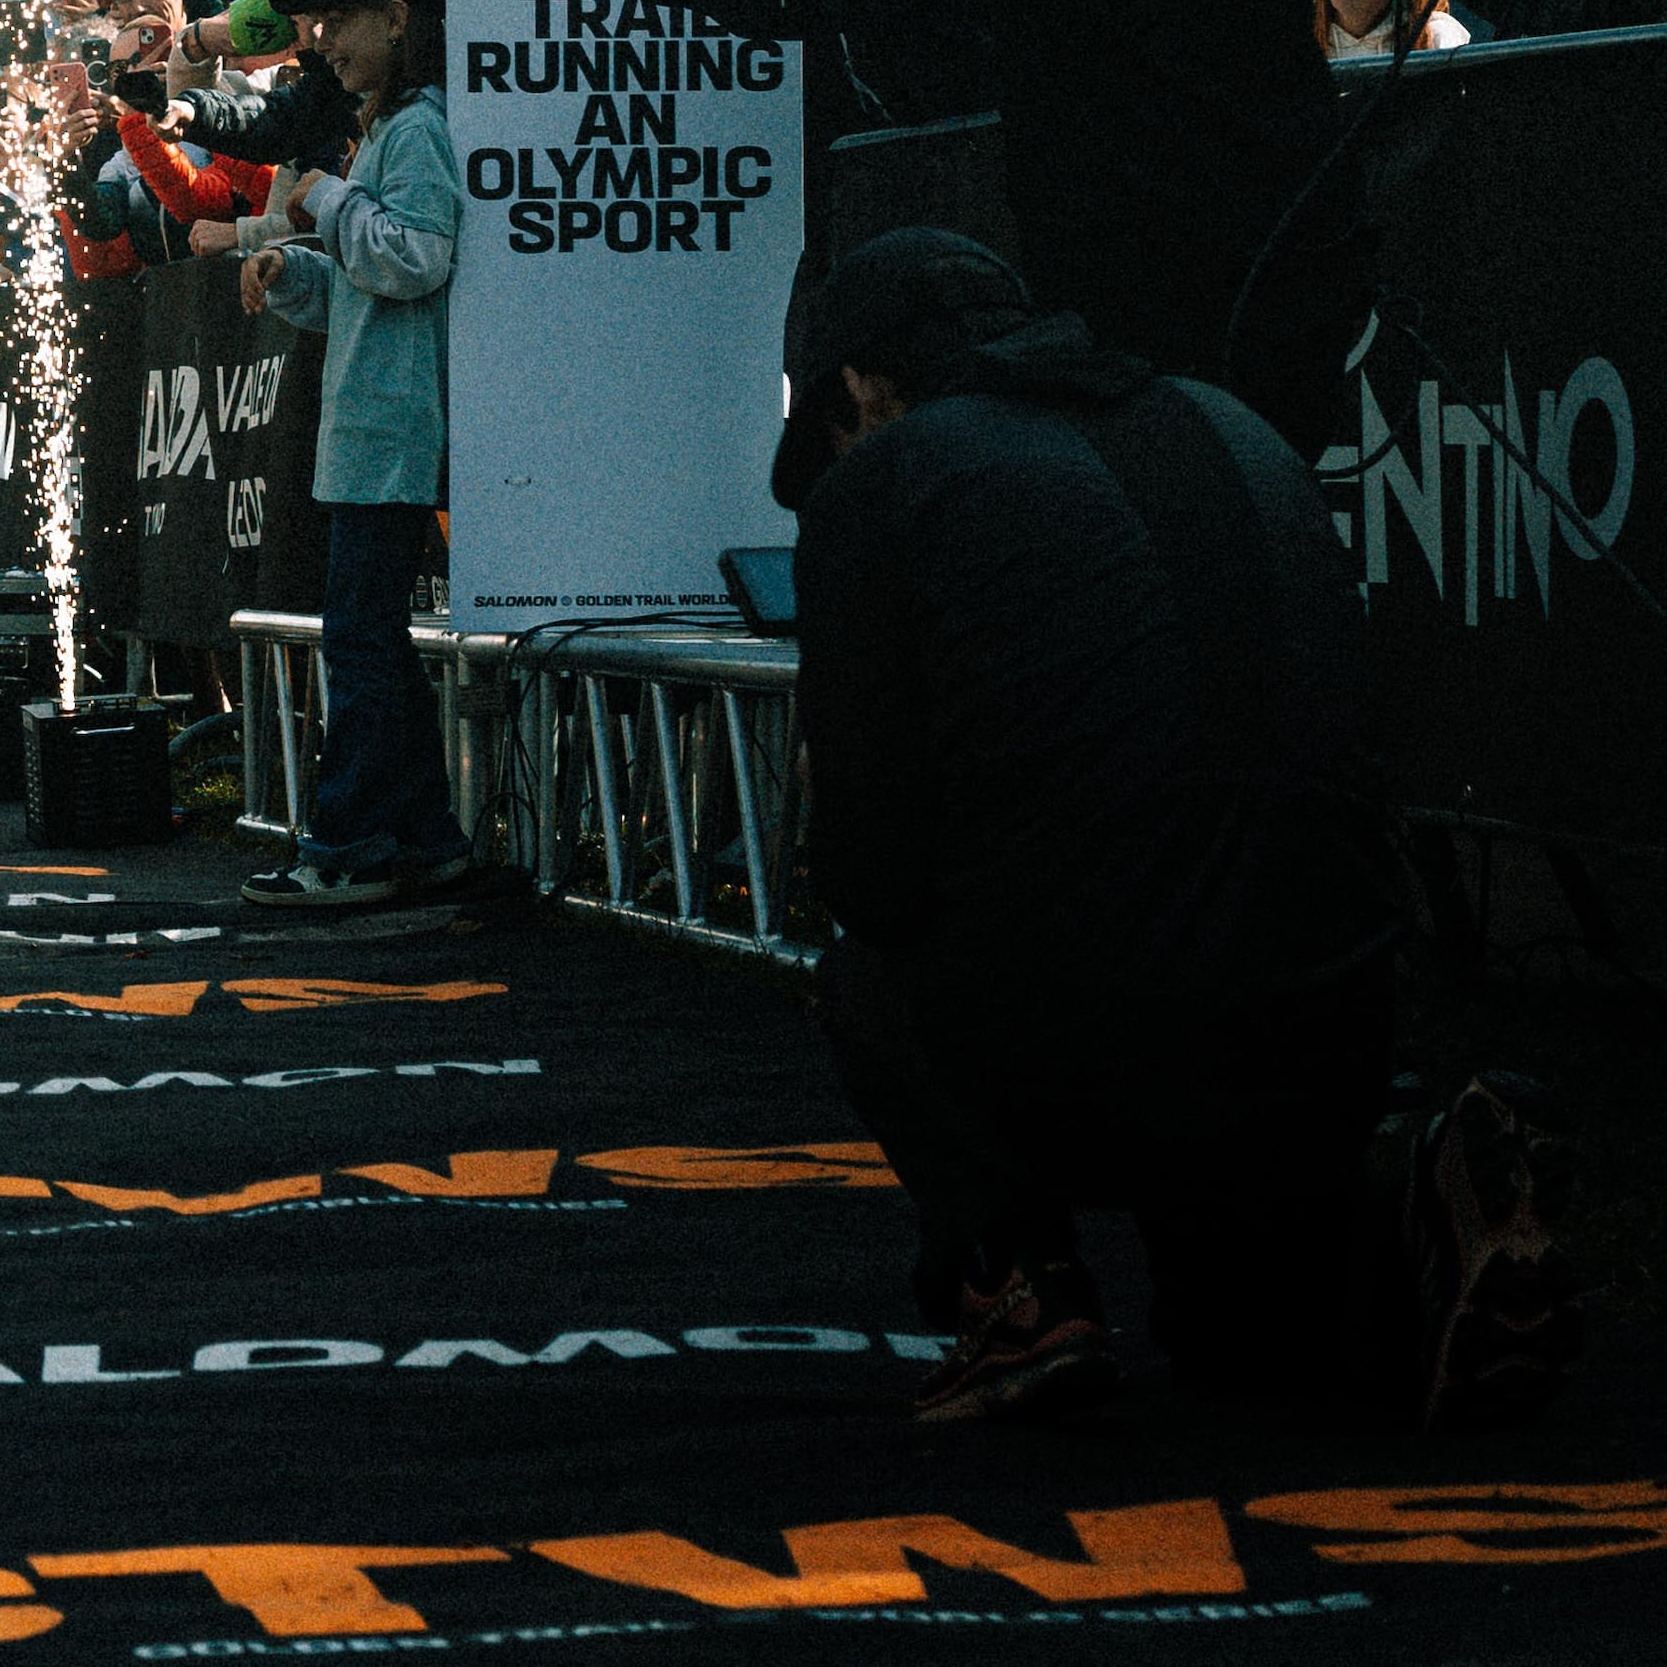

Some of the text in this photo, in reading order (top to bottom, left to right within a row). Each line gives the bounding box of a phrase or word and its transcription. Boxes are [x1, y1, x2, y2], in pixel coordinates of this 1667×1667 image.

[467, 41, 784, 93] RUNNING
[574, 94, 676, 146] AN
[467, 146, 772, 201] OLYMPIC
[509, 201, 744, 253] SPORT
[474, 594, 728, 608] SALOMON GOLDEN TRAIL WORLD
